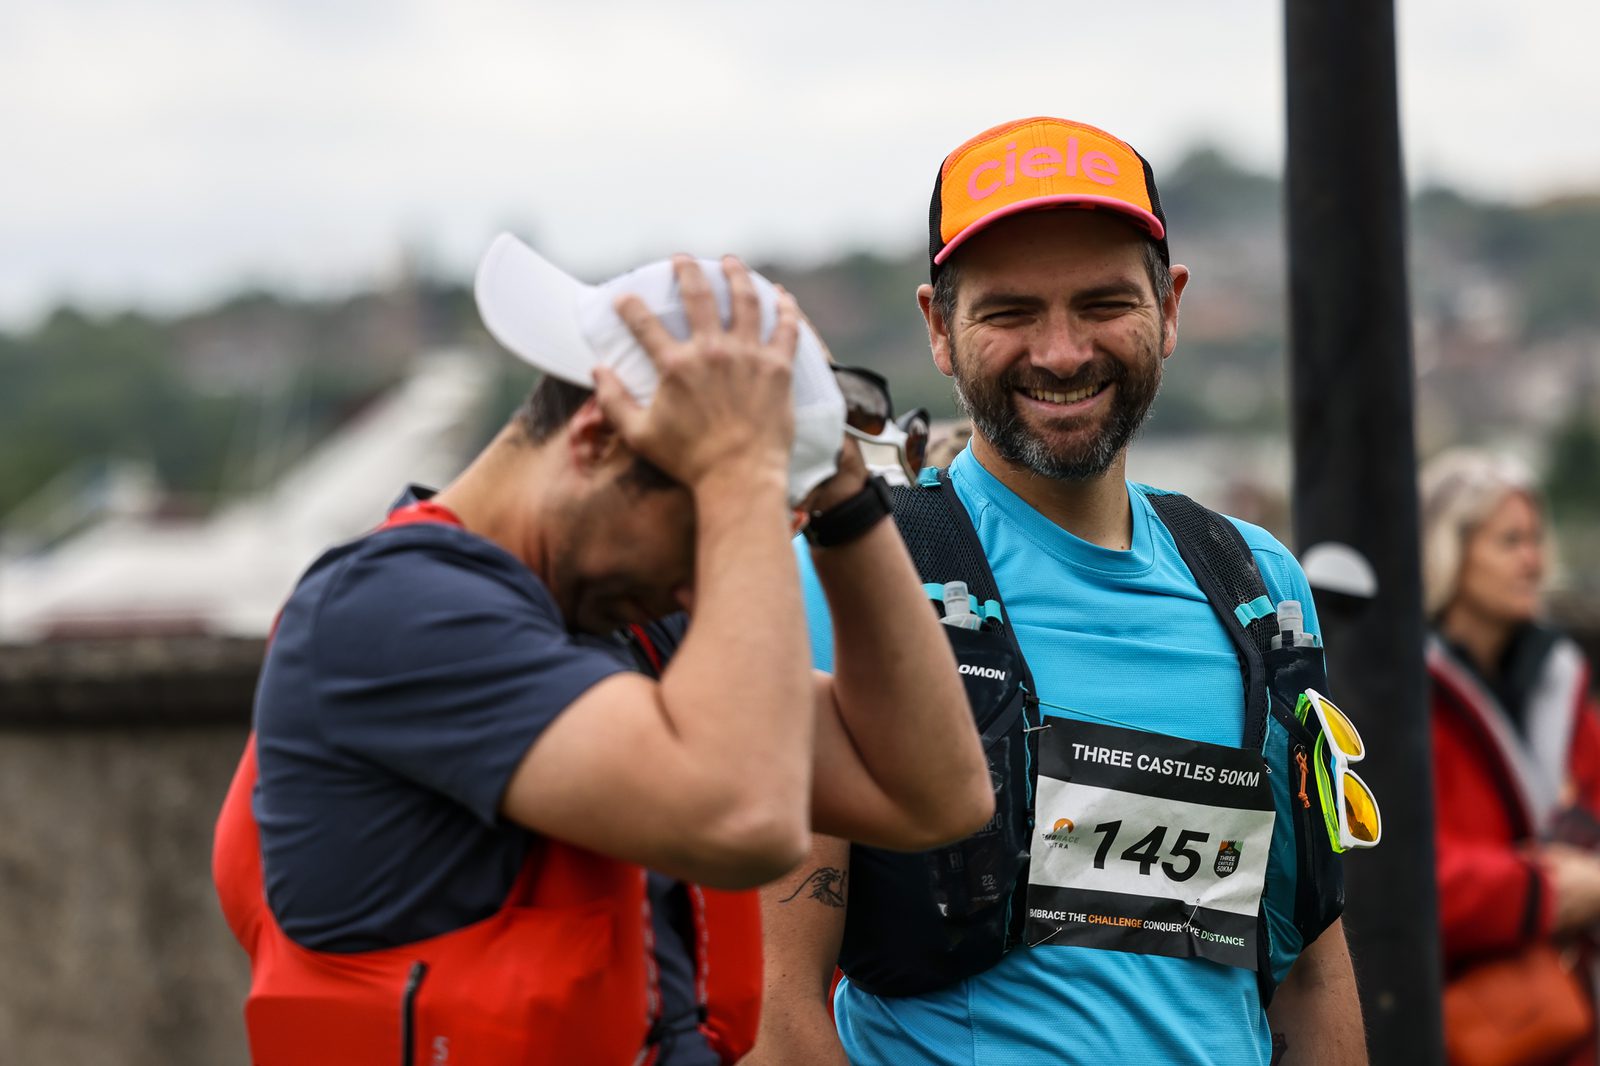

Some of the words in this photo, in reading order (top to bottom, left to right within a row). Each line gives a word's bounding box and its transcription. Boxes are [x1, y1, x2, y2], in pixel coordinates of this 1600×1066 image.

[967, 137, 1120, 201] ciele
[1071, 743, 1133, 768] THREE
[1136, 754, 1216, 782] CASTLES
[1218, 769, 1260, 787] 50KM
[1093, 819, 1210, 882] 145
[1068, 912, 1087, 923] THE
[1088, 914, 1143, 929] CHALLENGE
[1143, 920, 1182, 933] CONQUER
[1200, 930, 1246, 947] DISTANCE
